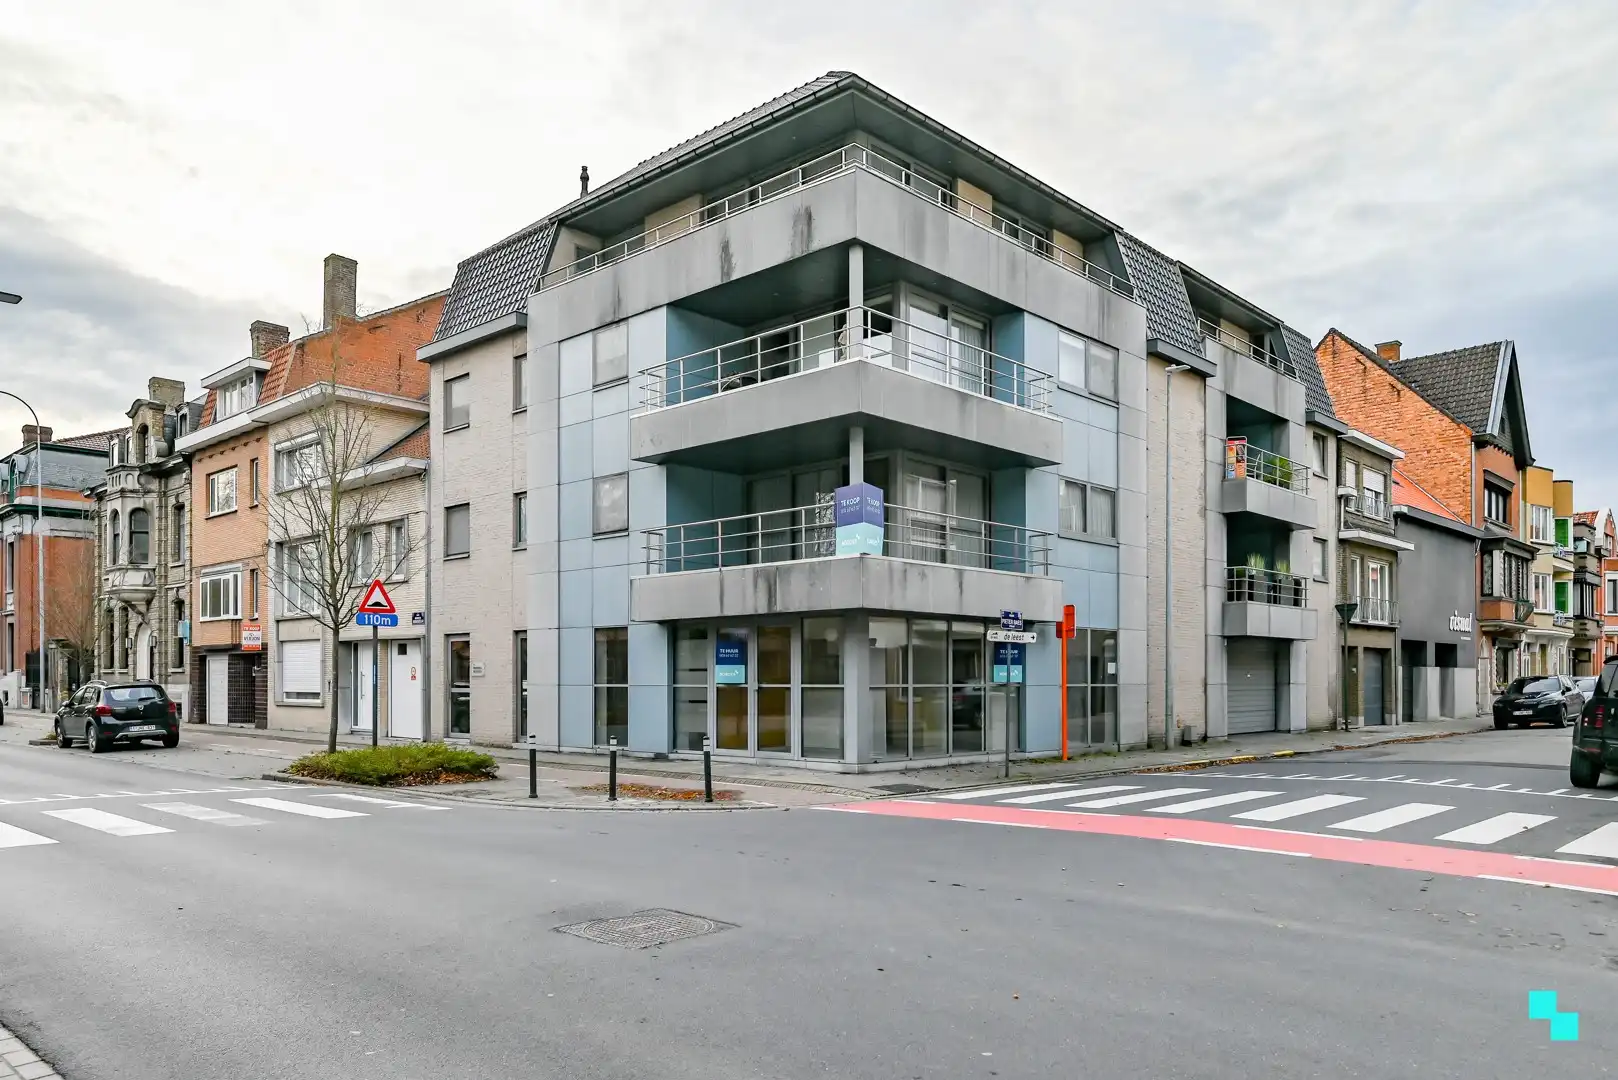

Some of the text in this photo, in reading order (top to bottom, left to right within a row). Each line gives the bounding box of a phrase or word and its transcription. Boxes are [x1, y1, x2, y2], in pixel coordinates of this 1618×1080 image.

[847, 496, 860, 506] KOOP
[364, 614, 391, 625] 110m
[1004, 633, 1025, 641] de leest
